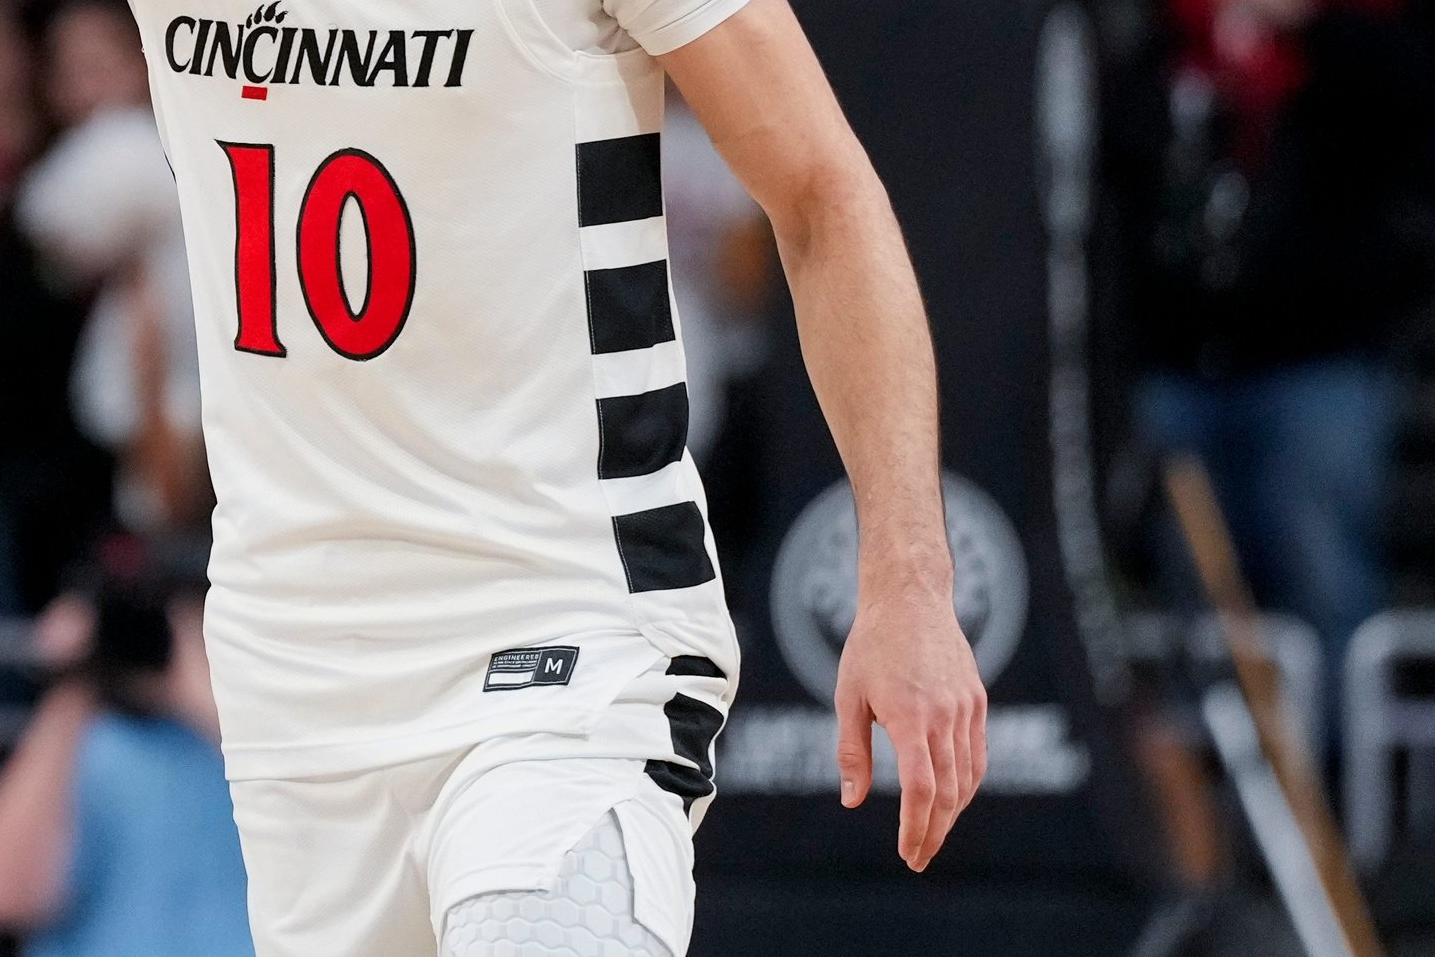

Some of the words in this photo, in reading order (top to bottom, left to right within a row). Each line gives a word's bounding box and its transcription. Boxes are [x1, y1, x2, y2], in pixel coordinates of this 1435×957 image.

[166, 15, 475, 88] CINCINNATI
[214, 138, 417, 362] 10
[544, 657, 564, 675] M
